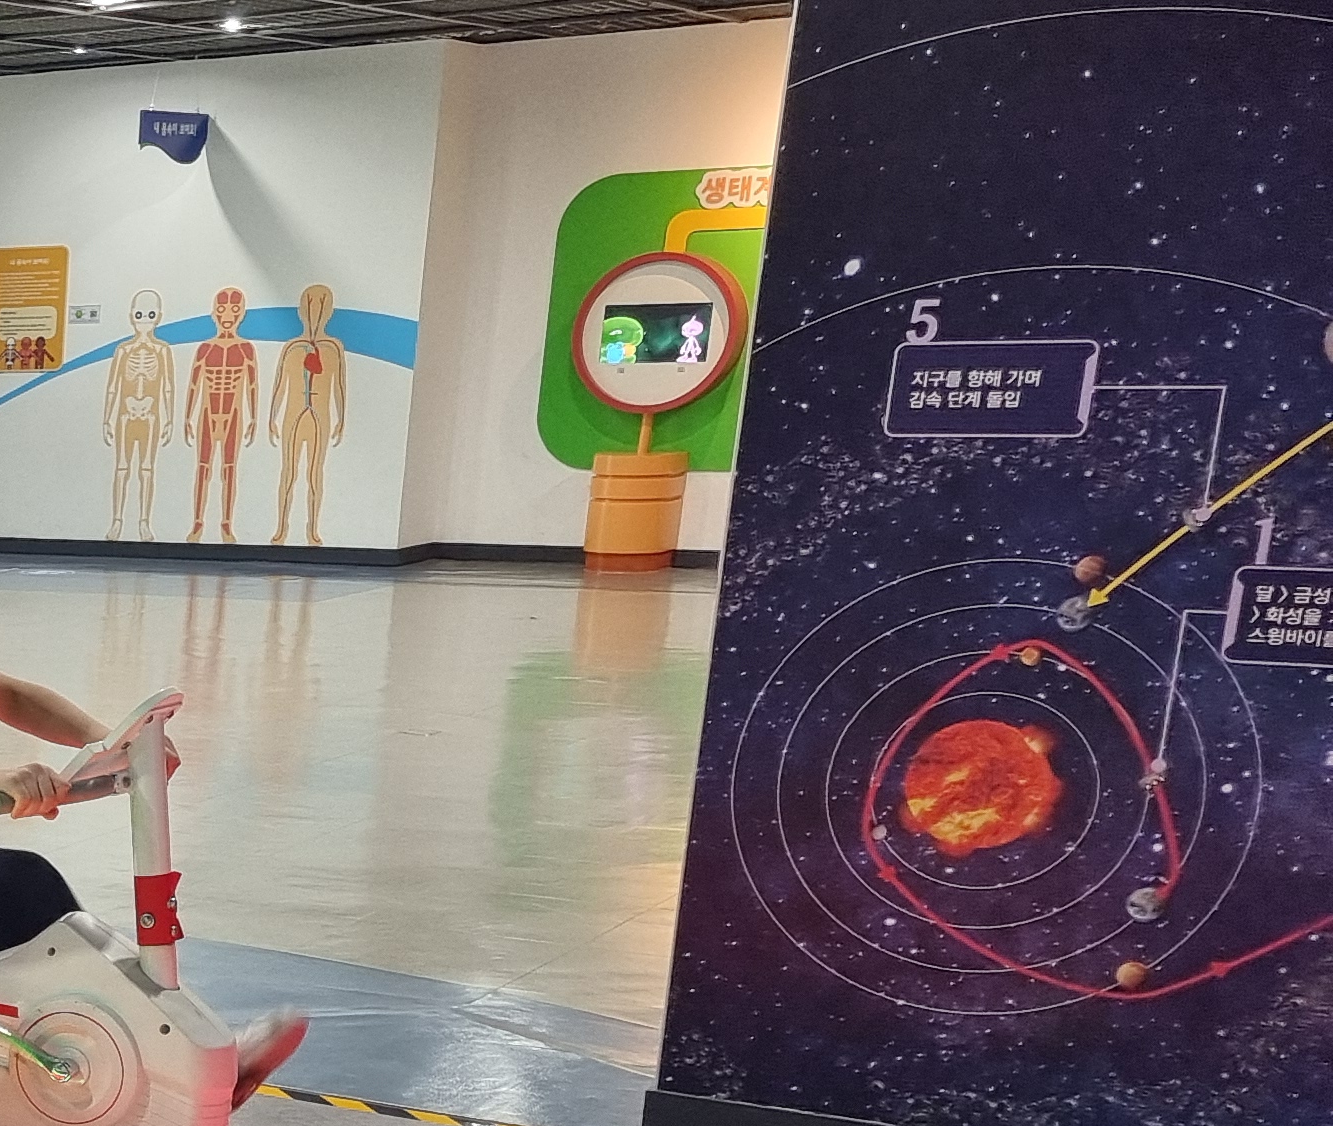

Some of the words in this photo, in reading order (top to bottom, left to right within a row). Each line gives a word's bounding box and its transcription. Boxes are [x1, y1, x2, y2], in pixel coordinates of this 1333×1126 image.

[905, 299, 941, 343] 5
[911, 370, 962, 388] 지구를
[967, 369, 1002, 387] 향해
[1006, 369, 1043, 387] 가며
[909, 391, 942, 409] 감속
[948, 391, 981, 408] 단계
[986, 391, 1021, 408] 돌입
[1254, 517, 1276, 565] 1
[1256, 585, 1275, 603] 달
[1293, 586, 1331, 605] 금성
[1264, 606, 1323, 626] 화성을
